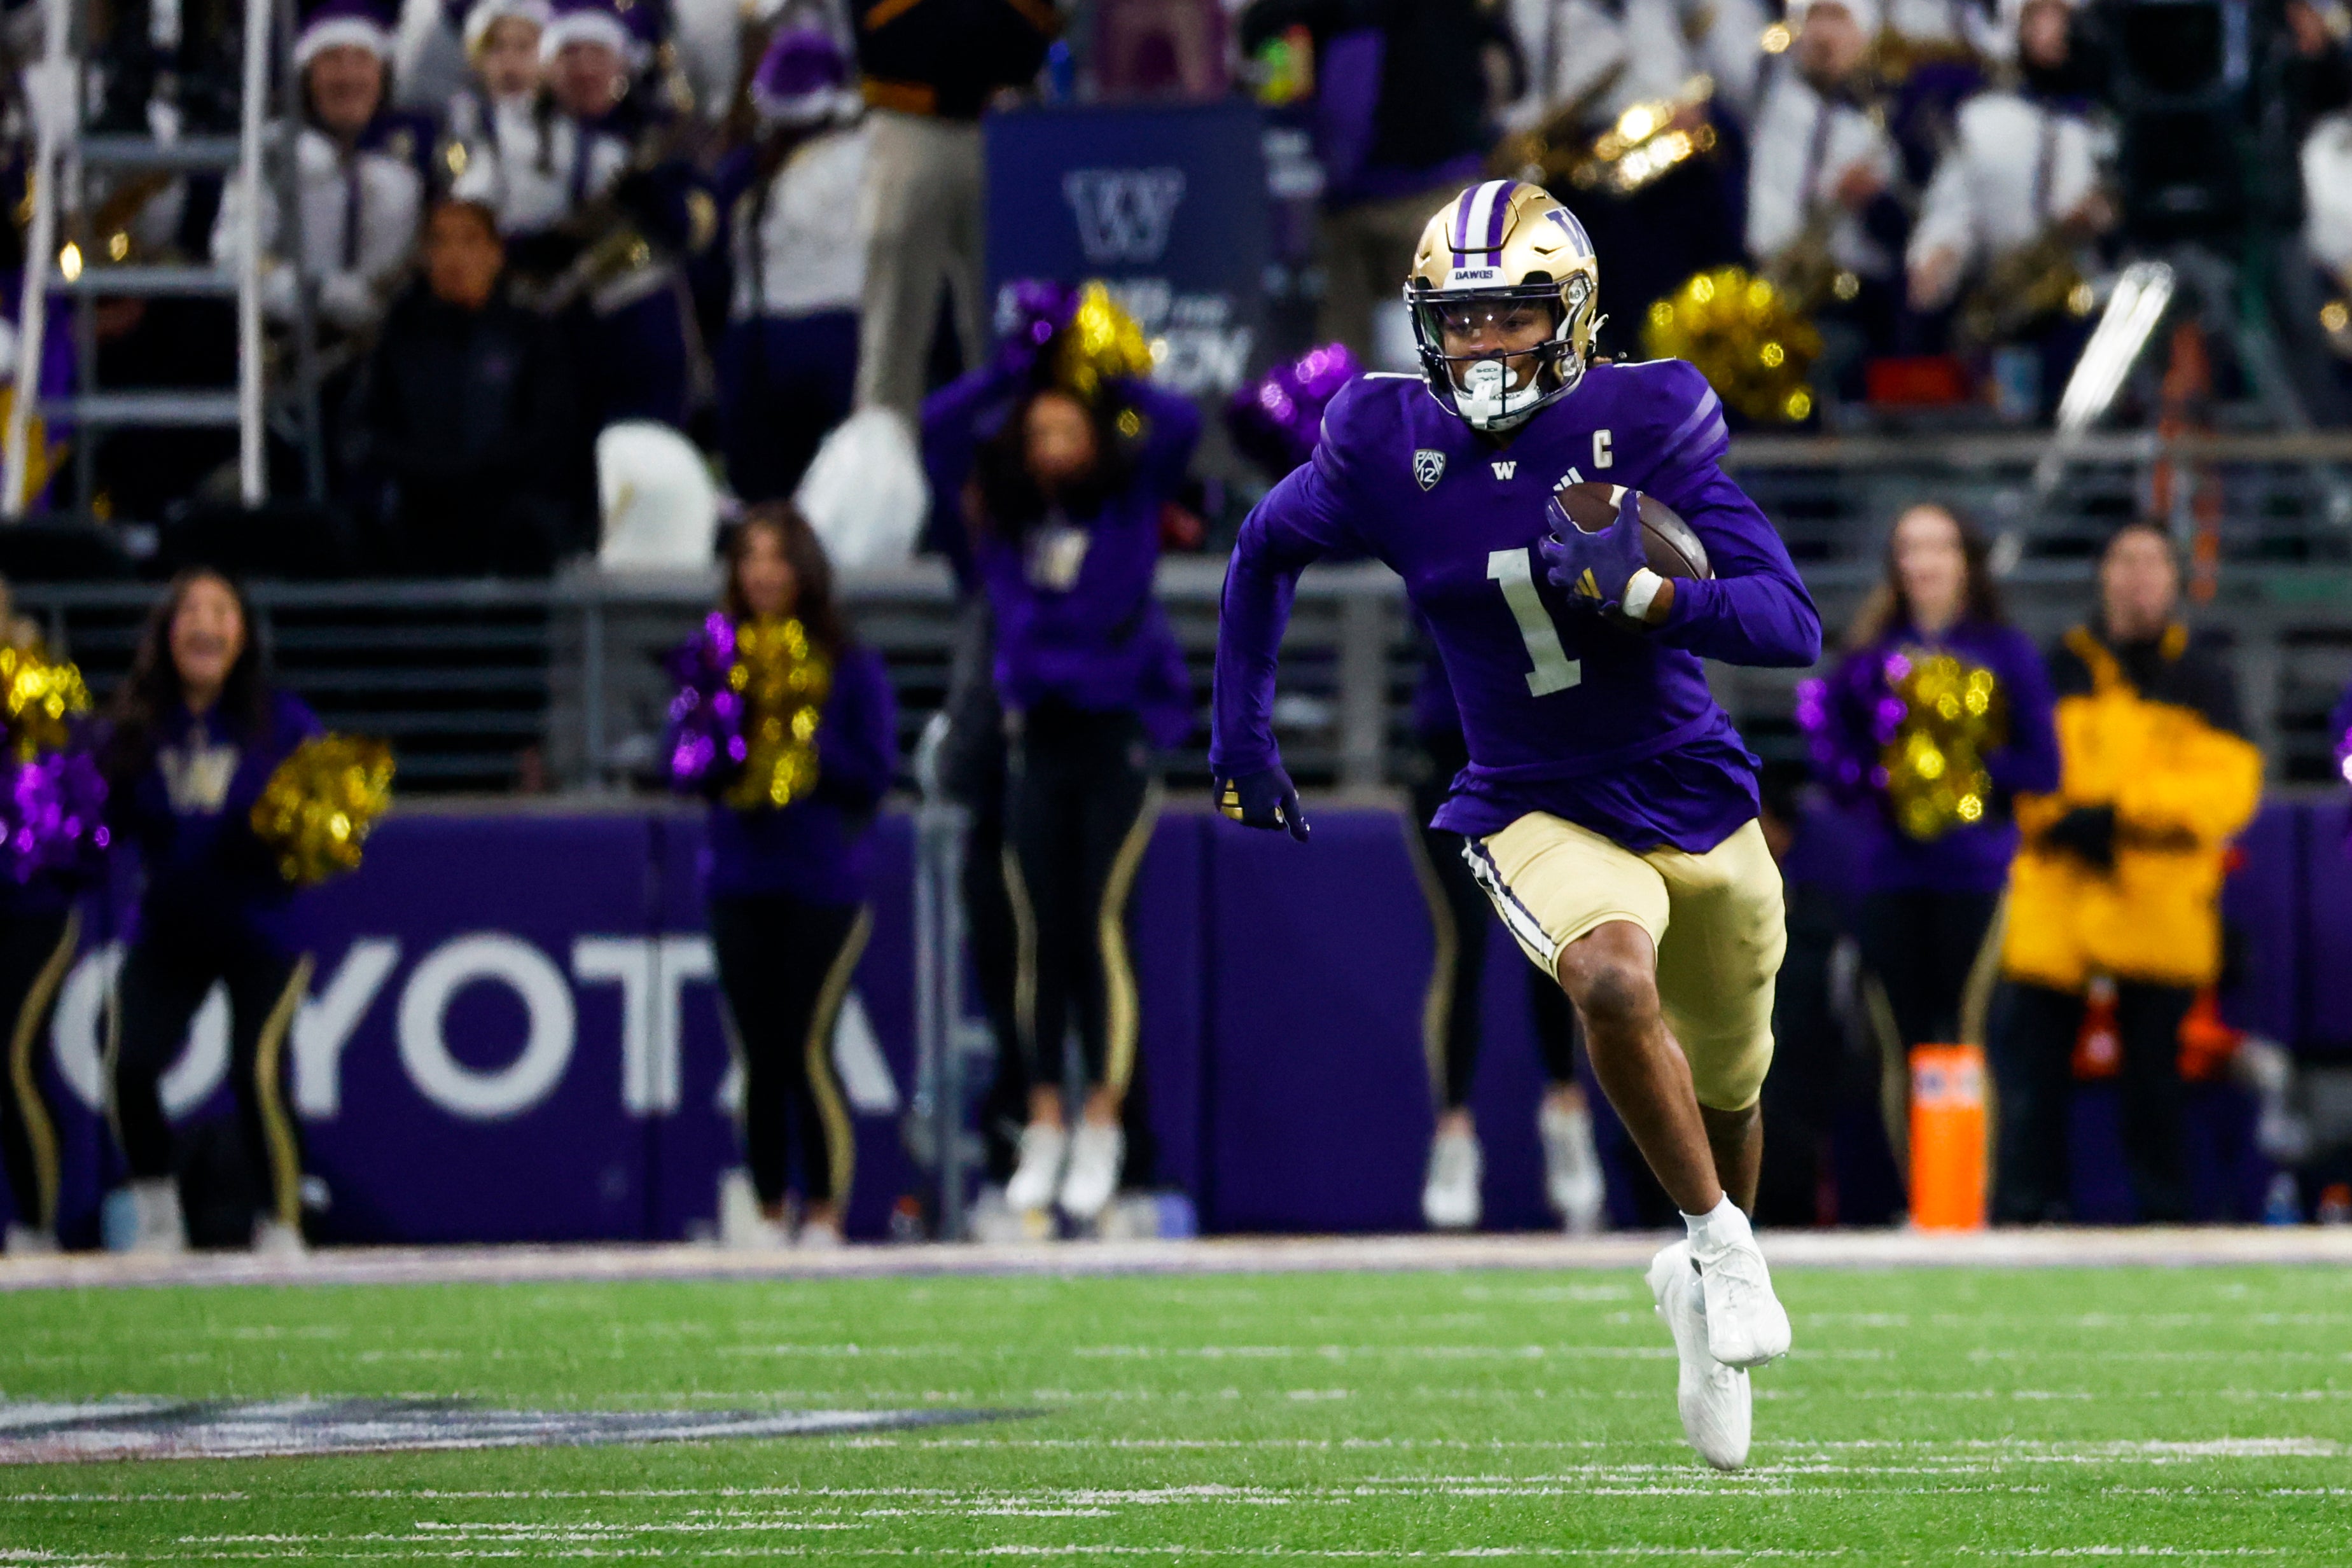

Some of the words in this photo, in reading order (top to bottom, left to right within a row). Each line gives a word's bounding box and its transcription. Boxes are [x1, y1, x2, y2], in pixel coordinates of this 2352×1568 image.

[1455, 270, 1493, 280] DAWGS
[1592, 429, 1613, 469] C
[1415, 450, 1444, 476] PAC
[1491, 461, 1517, 480] W
[1419, 467, 1436, 483] 12
[1487, 548, 1582, 697] 1
